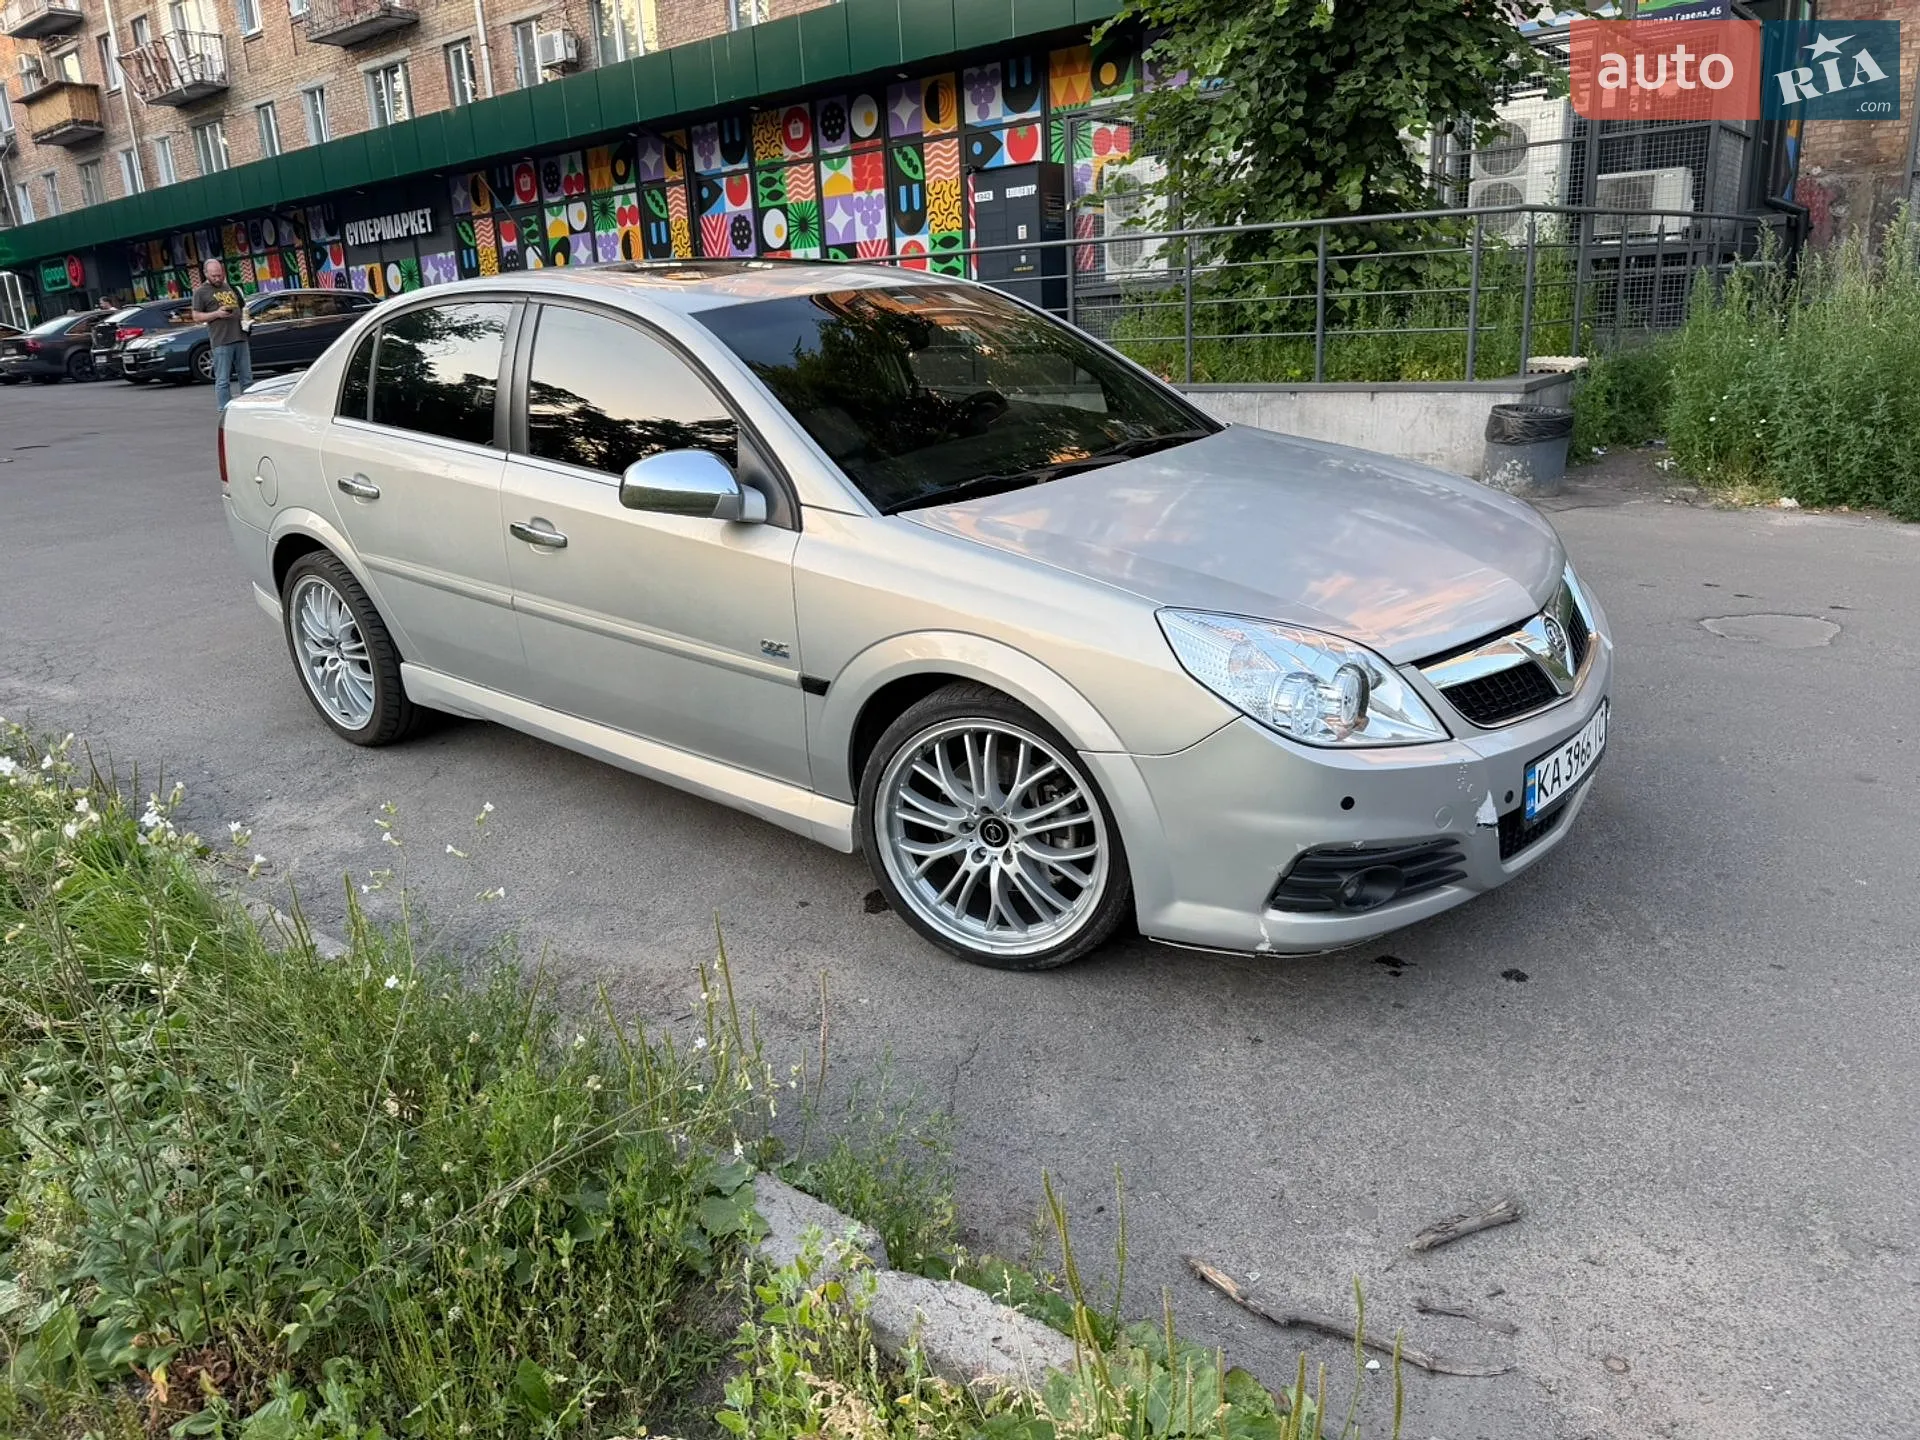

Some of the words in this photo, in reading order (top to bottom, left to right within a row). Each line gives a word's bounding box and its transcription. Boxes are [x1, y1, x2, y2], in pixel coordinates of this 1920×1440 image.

[345, 207, 432, 246] СУПЕРМАРКЕТ
[1537, 757, 1561, 804] KA
[1565, 725, 1592, 782] 3966
